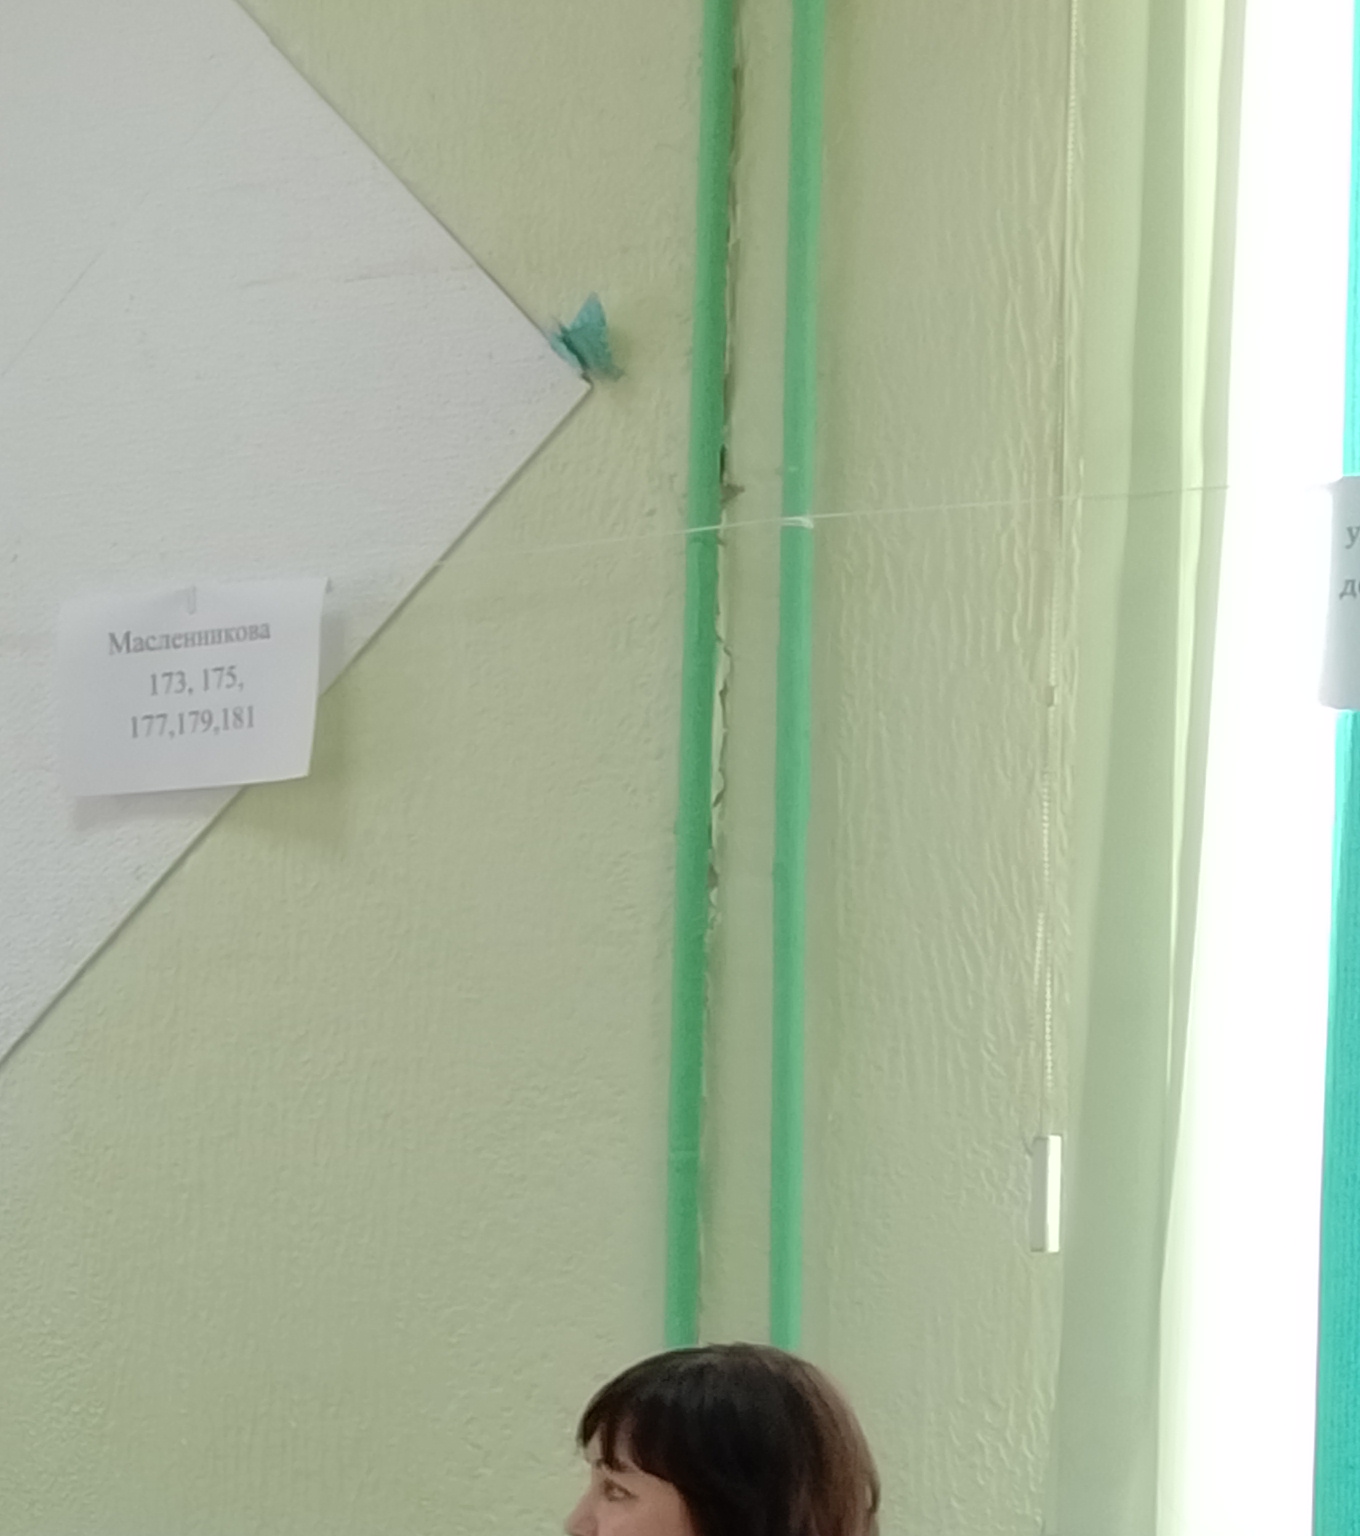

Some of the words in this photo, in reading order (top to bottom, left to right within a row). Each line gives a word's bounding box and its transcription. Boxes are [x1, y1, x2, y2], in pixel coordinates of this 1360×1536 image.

[108, 623, 271, 655] Масленникова
[150, 670, 194, 696] 173,
[202, 665, 245, 693] 175,
